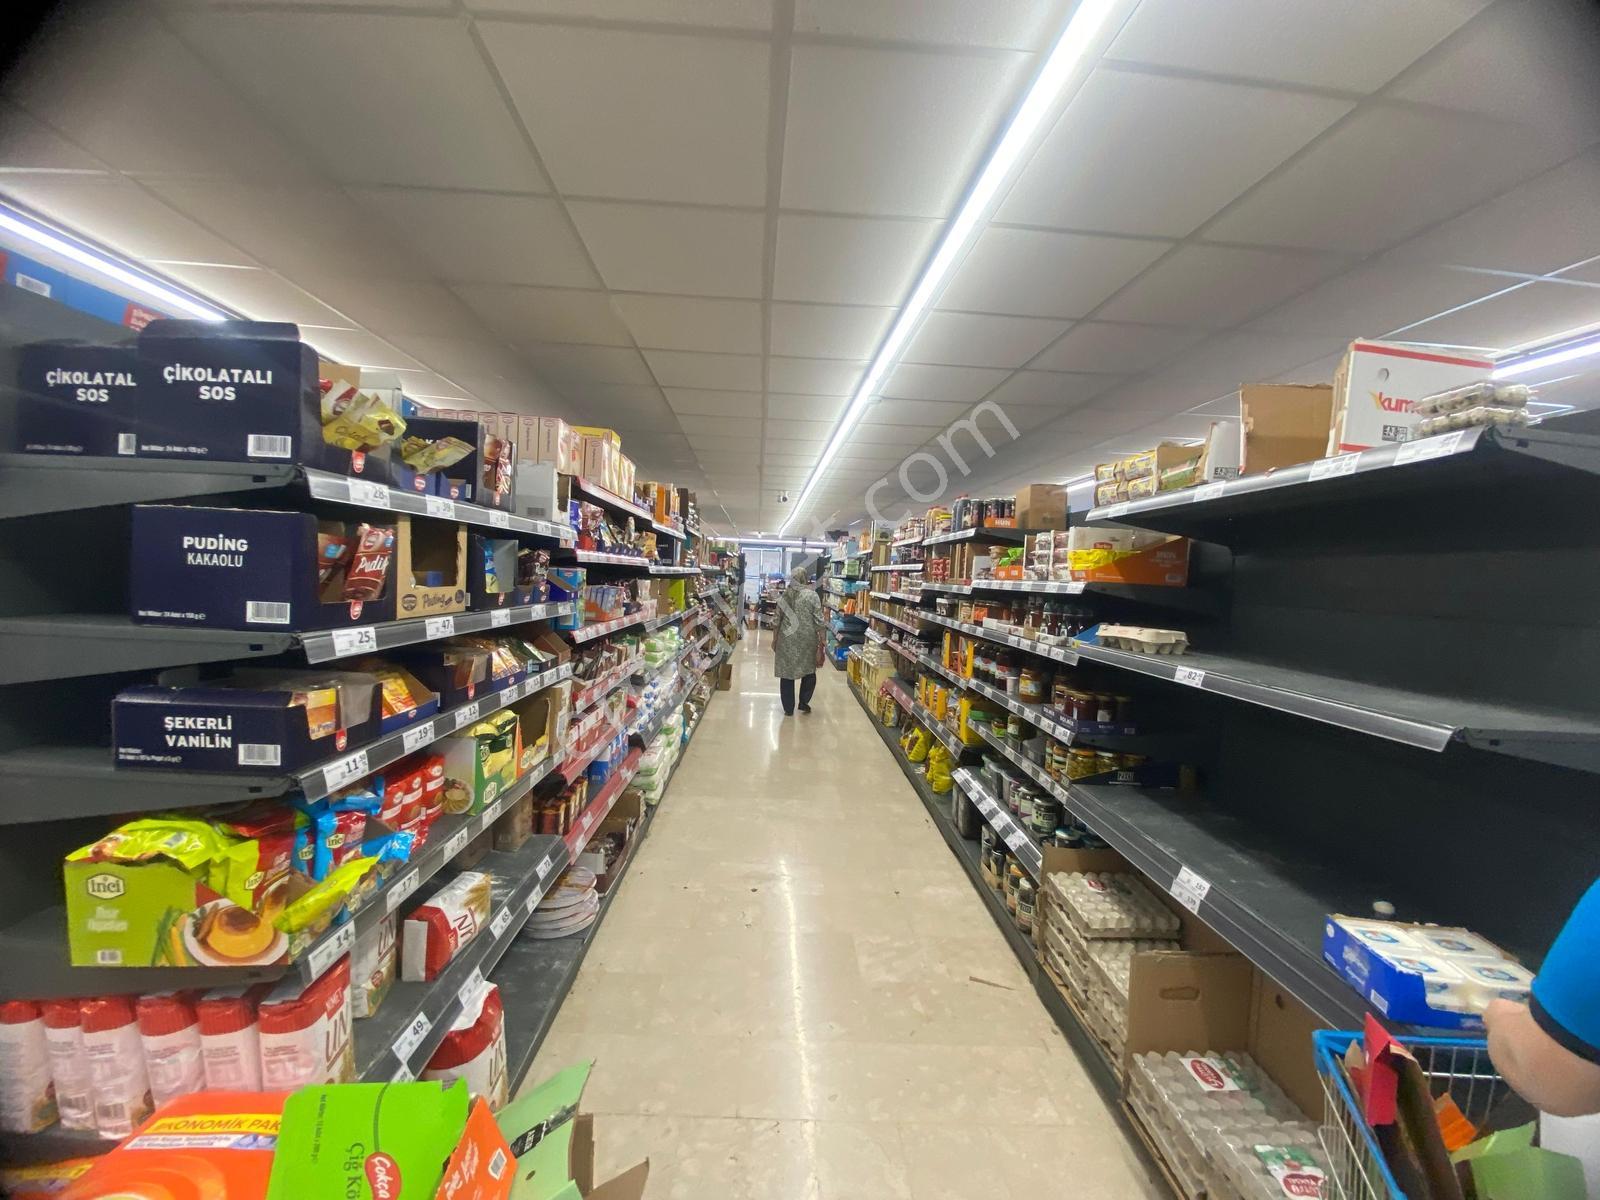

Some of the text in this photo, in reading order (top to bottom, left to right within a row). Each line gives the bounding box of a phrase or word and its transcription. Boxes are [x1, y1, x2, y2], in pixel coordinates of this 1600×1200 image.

[46, 367, 137, 387] ÇİKOLATAL
[163, 363, 273, 385] ÇİKOLATALI
[76, 388, 109, 402] SOS
[199, 386, 236, 401] SOS
[1379, 391, 1420, 414] kum
[183, 534, 248, 552] PUDİNG
[187, 552, 243, 567] KAKAOLU
[441, 620, 450, 629] 47
[358, 632, 370, 644] 25
[1187, 671, 1198, 680] 82
[468, 706, 476, 716] 12
[164, 715, 232, 731] ŞEKERLİ
[165, 733, 232, 748] VANİLİN
[418, 727, 428, 740] 19
[345, 759, 358, 773] 11
[402, 877, 412, 891] 17
[336, 929, 349, 947] 14
[326, 1001, 350, 1063] UN
[412, 1020, 424, 1036] 49
[248, 1119, 281, 1131] PAK
